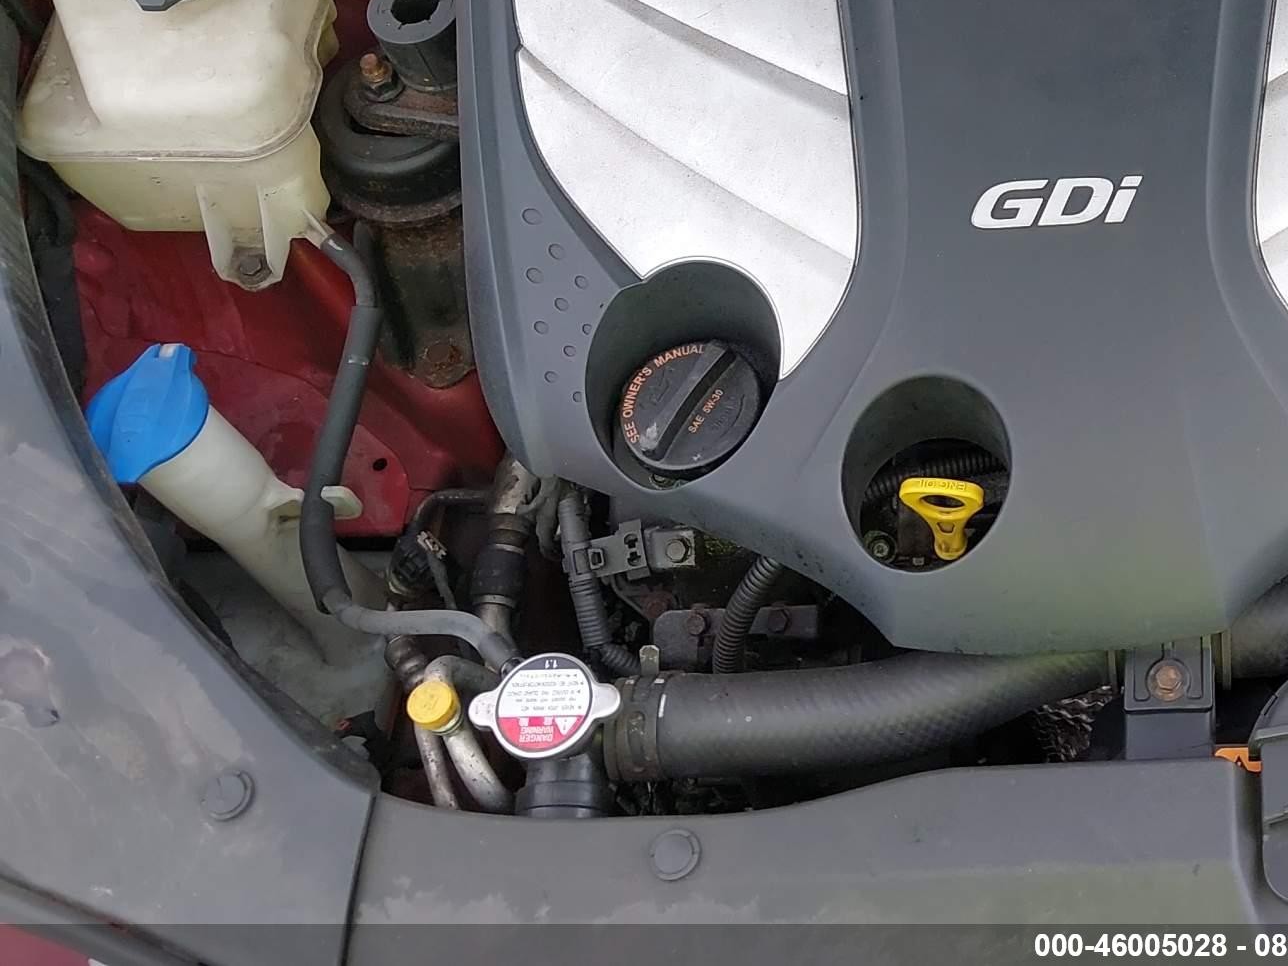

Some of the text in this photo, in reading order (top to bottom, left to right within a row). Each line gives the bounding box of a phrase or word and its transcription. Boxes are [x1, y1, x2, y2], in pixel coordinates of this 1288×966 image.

[970, 175, 1144, 229] GDi
[622, 344, 705, 444] SEE OWNER'S MANUAL
[687, 389, 724, 433] SAE 5W-30
[544, 659, 558, 669] 1.1
[519, 733, 554, 743] DANGER
